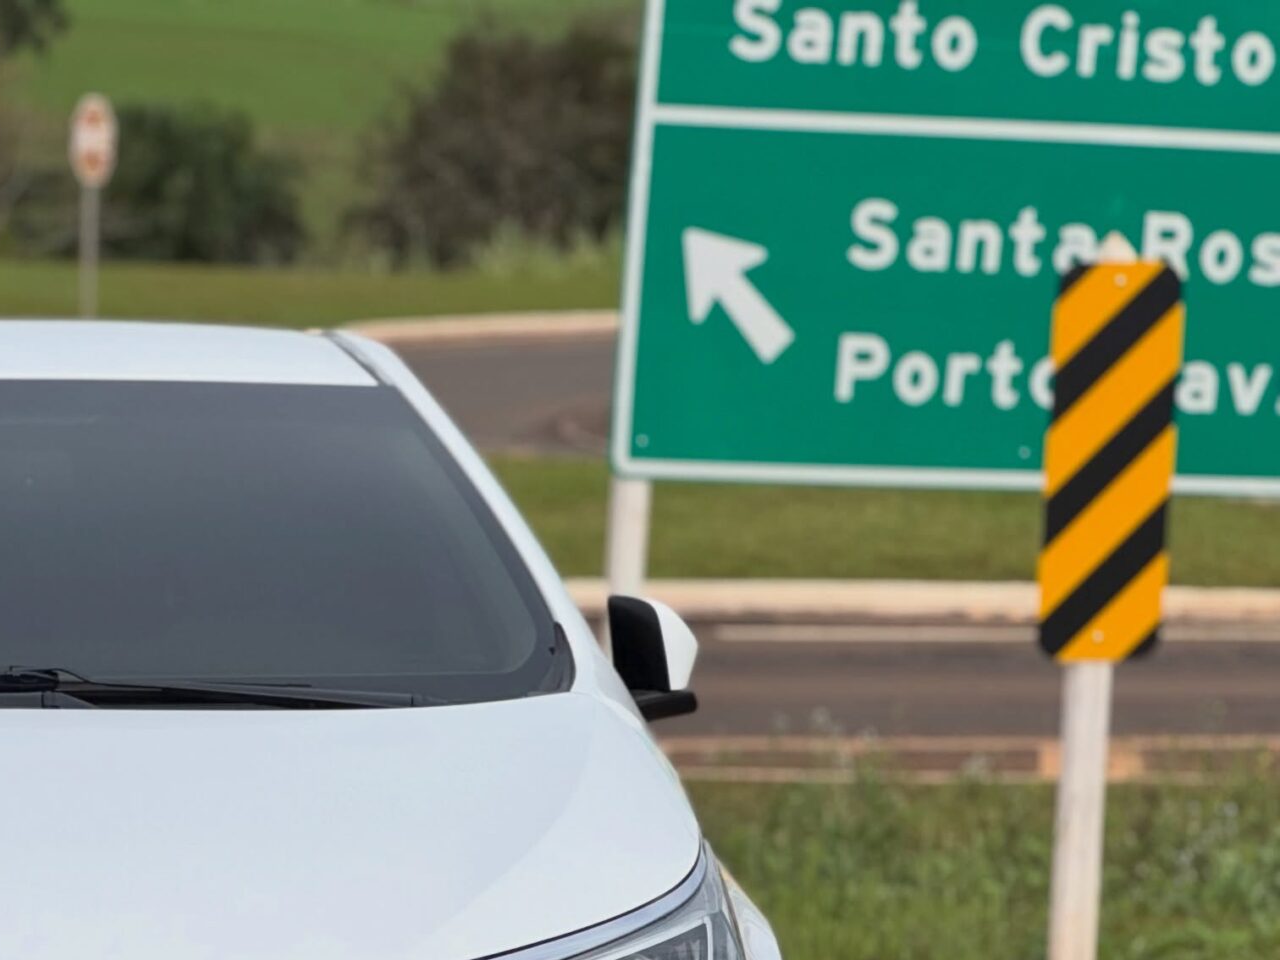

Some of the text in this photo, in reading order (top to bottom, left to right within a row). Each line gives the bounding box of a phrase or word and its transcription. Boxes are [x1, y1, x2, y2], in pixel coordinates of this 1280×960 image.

[727, 0, 1276, 87] Santo Cristo
[846, 198, 1098, 277] Santa
